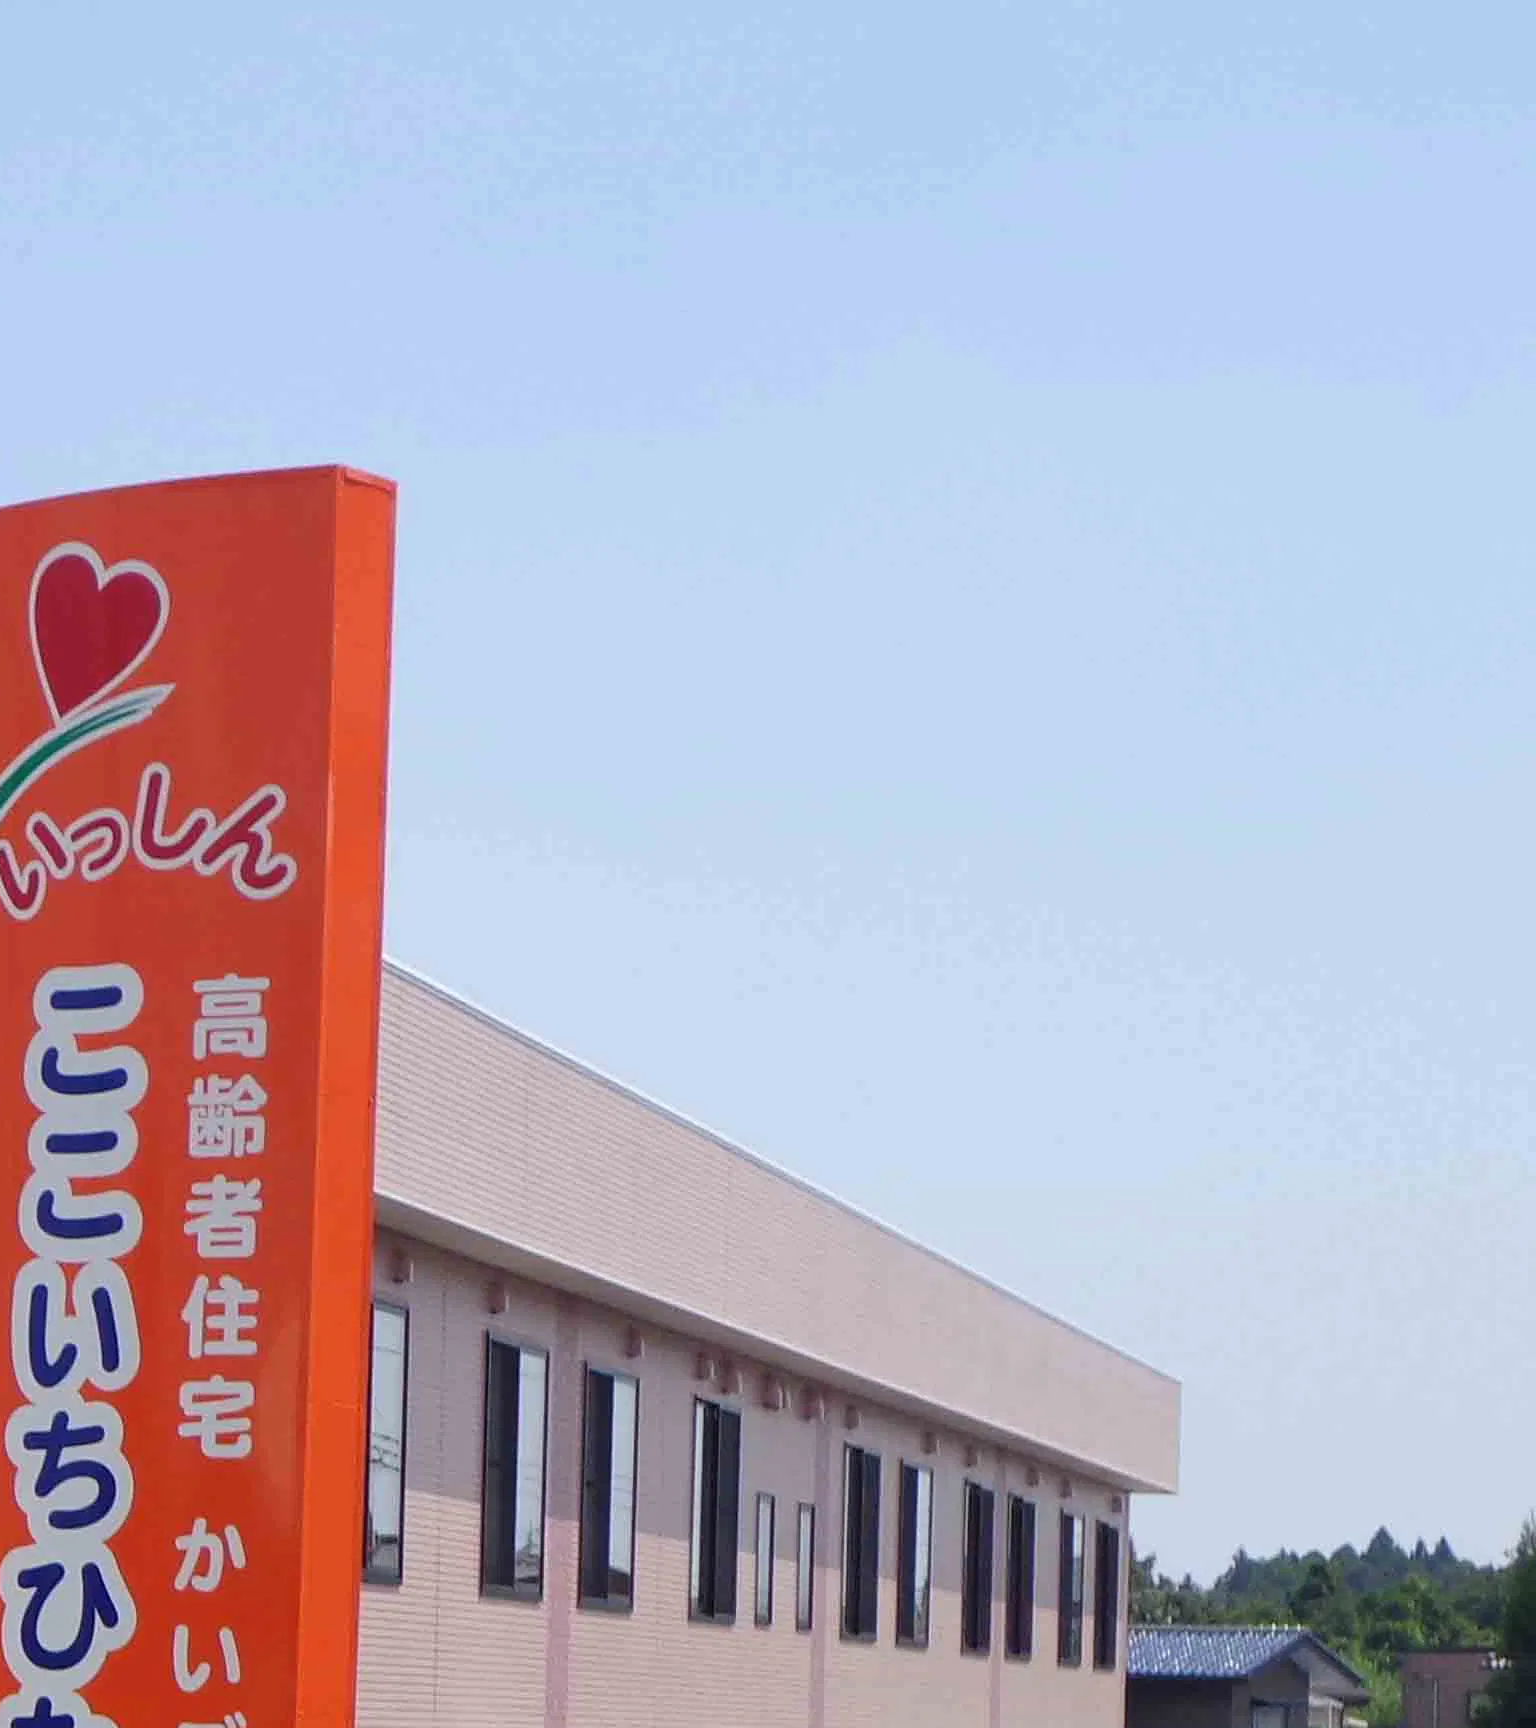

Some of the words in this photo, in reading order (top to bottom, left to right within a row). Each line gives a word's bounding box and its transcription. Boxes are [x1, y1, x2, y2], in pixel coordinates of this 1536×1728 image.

[178, 973, 271, 1459] 高齢者住宅
